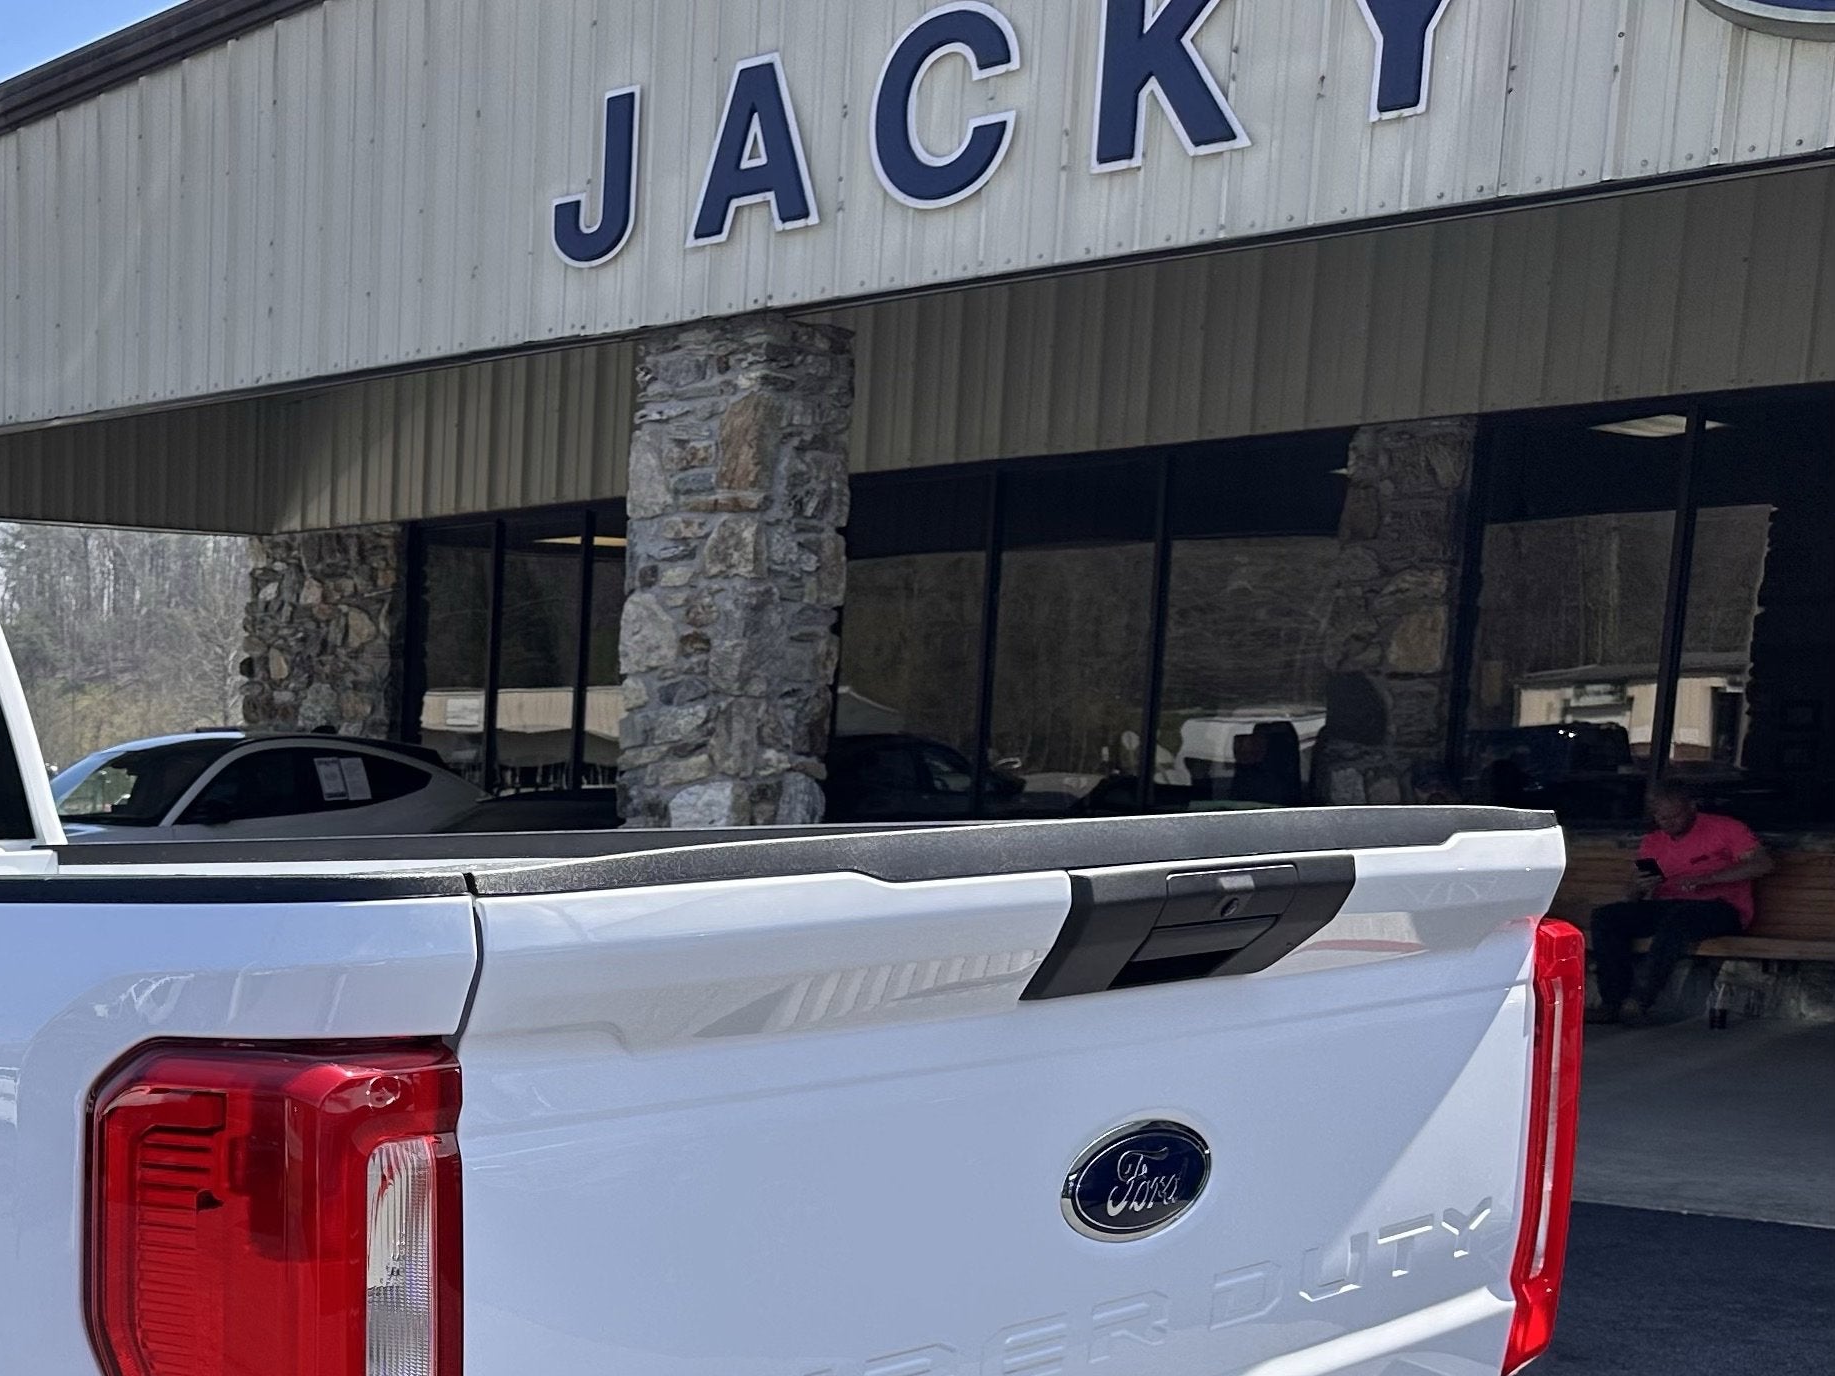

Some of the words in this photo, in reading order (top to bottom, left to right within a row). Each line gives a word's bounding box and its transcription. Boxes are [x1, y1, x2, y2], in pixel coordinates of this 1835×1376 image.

[553, 0, 1450, 268] JACKY
[1106, 1147, 1189, 1217] Ford
[1210, 1196, 1493, 1331] DUTY
